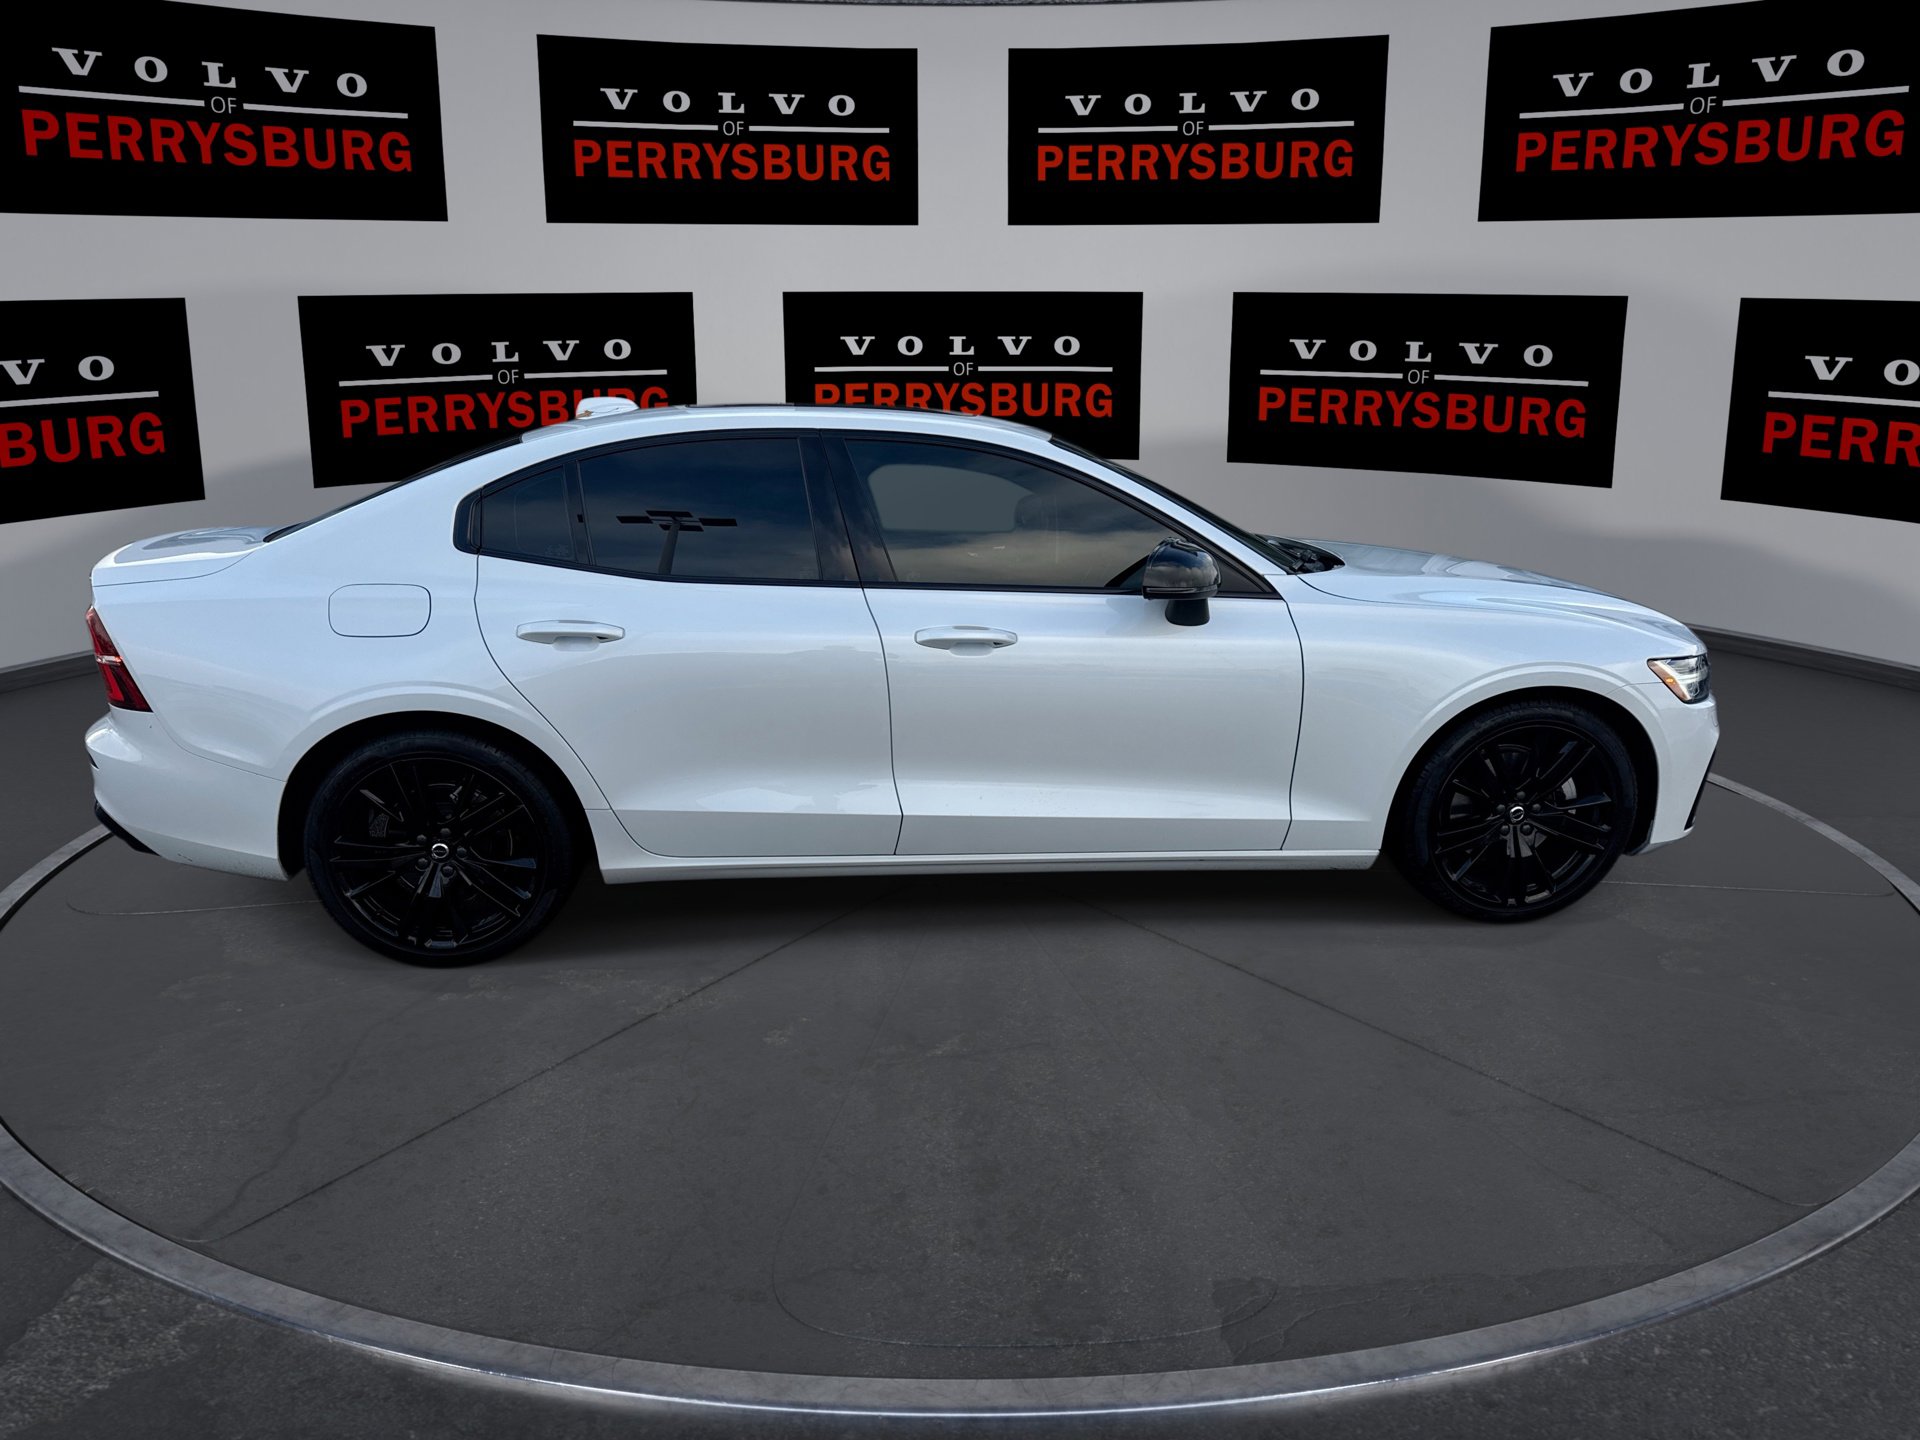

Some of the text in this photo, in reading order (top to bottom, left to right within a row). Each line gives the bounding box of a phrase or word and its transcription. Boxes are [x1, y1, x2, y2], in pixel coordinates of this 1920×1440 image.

[52, 48, 368, 98] VOLVO
[1553, 49, 1865, 97] VOLVO
[211, 97, 236, 114] OF
[601, 88, 856, 116] VOLVO
[1066, 89, 1320, 116] VOLVO
[1690, 97, 1717, 115] OF
[23, 109, 412, 172] PERRYSBURG
[722, 120, 746, 136] OF
[1181, 120, 1206, 136] OF
[1516, 109, 1905, 172] PERRYSBURG
[574, 139, 890, 182] PERRYSBURG
[1037, 139, 1353, 182] PERRYSBURG
[366, 338, 632, 367] VOLVO
[840, 335, 1081, 356] VOLVO
[1290, 338, 1553, 367] VOLVO
[497, 369, 520, 385] OF
[953, 362, 974, 376] OF
[1407, 369, 1430, 385] OF
[1258, 386, 1585, 438] PERRYSBURG
